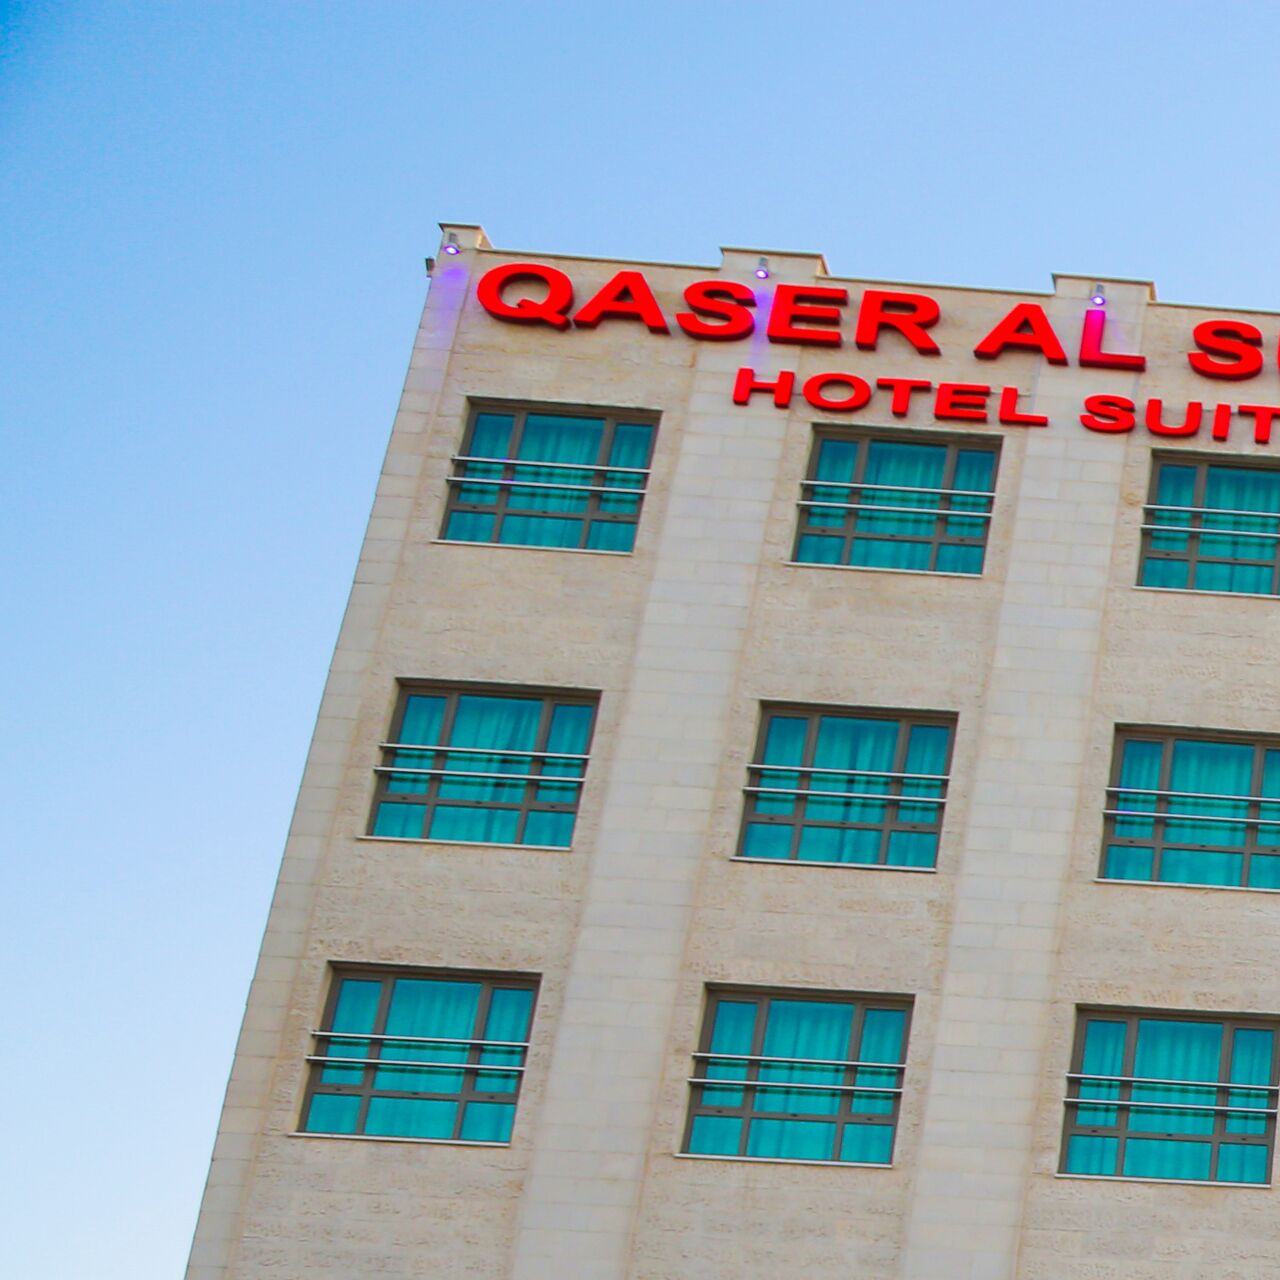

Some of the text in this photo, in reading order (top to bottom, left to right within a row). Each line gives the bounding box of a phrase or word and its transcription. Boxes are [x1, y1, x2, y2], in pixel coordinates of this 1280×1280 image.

[476, 262, 942, 351] QASER
[974, 302, 1147, 372] AL
[732, 367, 1049, 428] HOTEL
